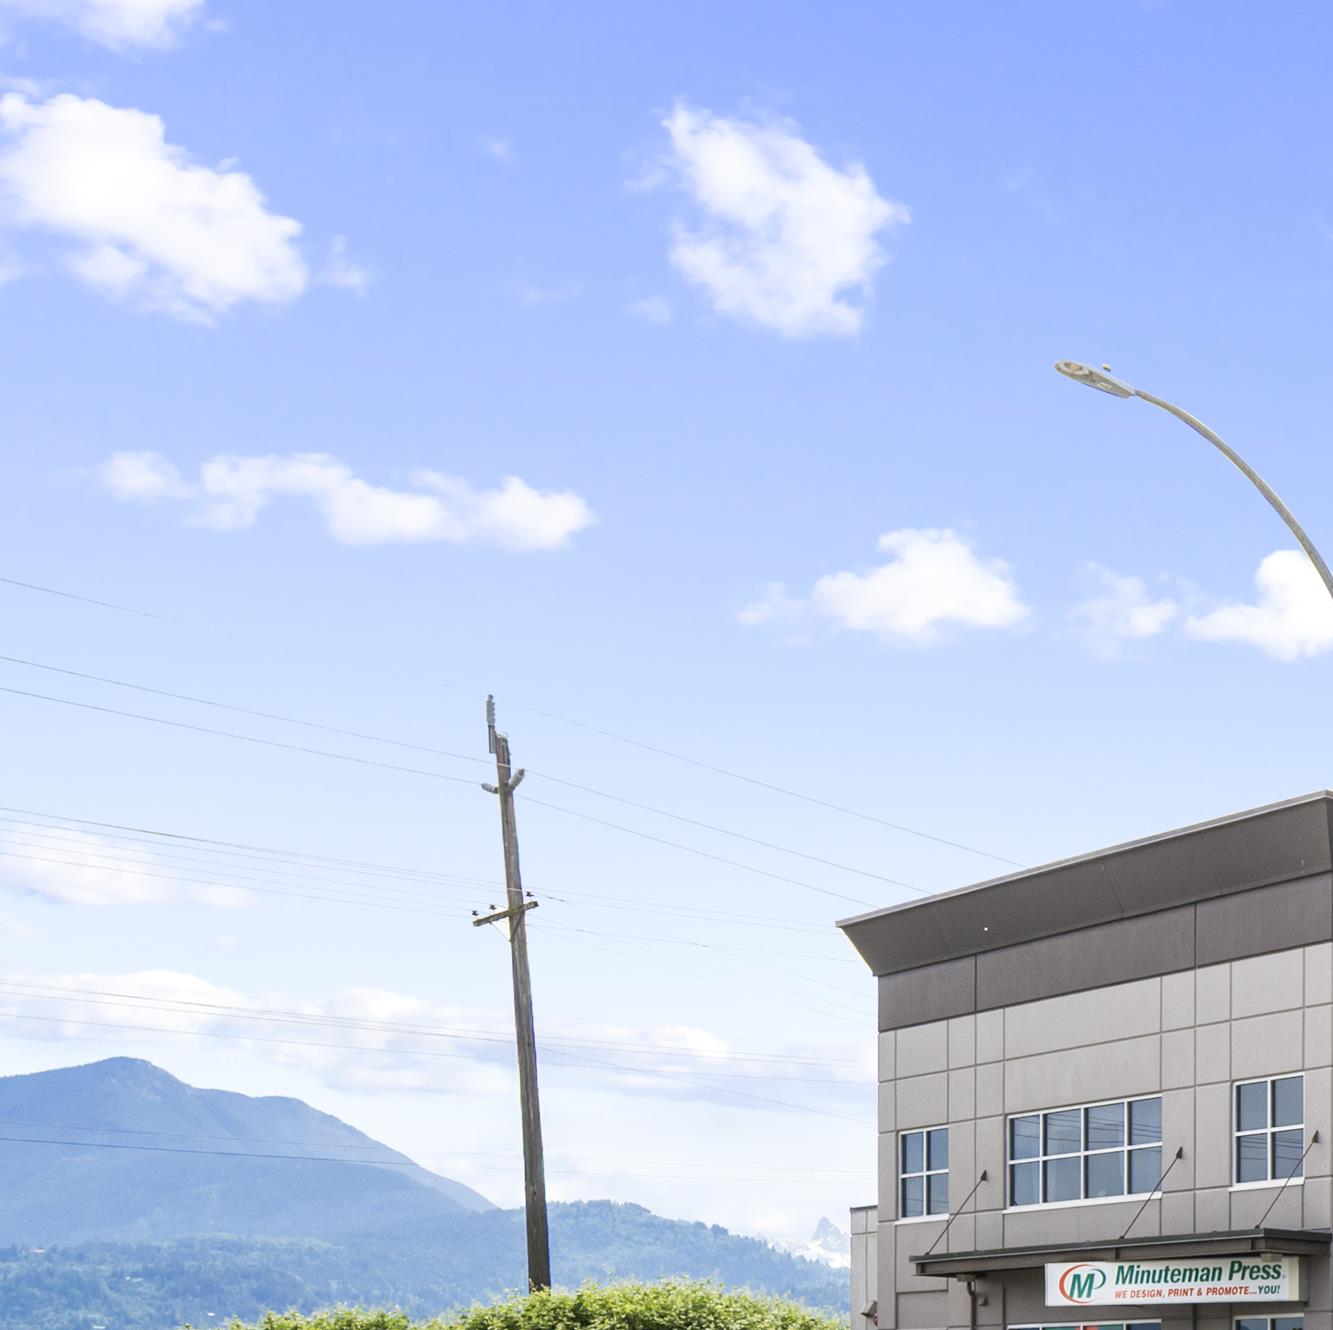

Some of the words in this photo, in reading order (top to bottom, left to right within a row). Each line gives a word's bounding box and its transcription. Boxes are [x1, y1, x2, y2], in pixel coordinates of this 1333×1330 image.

[1115, 1264, 1223, 1285] Minuteman
[1228, 1260, 1282, 1281] Press
[1115, 1289, 1128, 1299] WE
[1130, 1288, 1165, 1300] DESIGN,
[1168, 1287, 1194, 1297] PRINT
[1197, 1287, 1203, 1296] &
